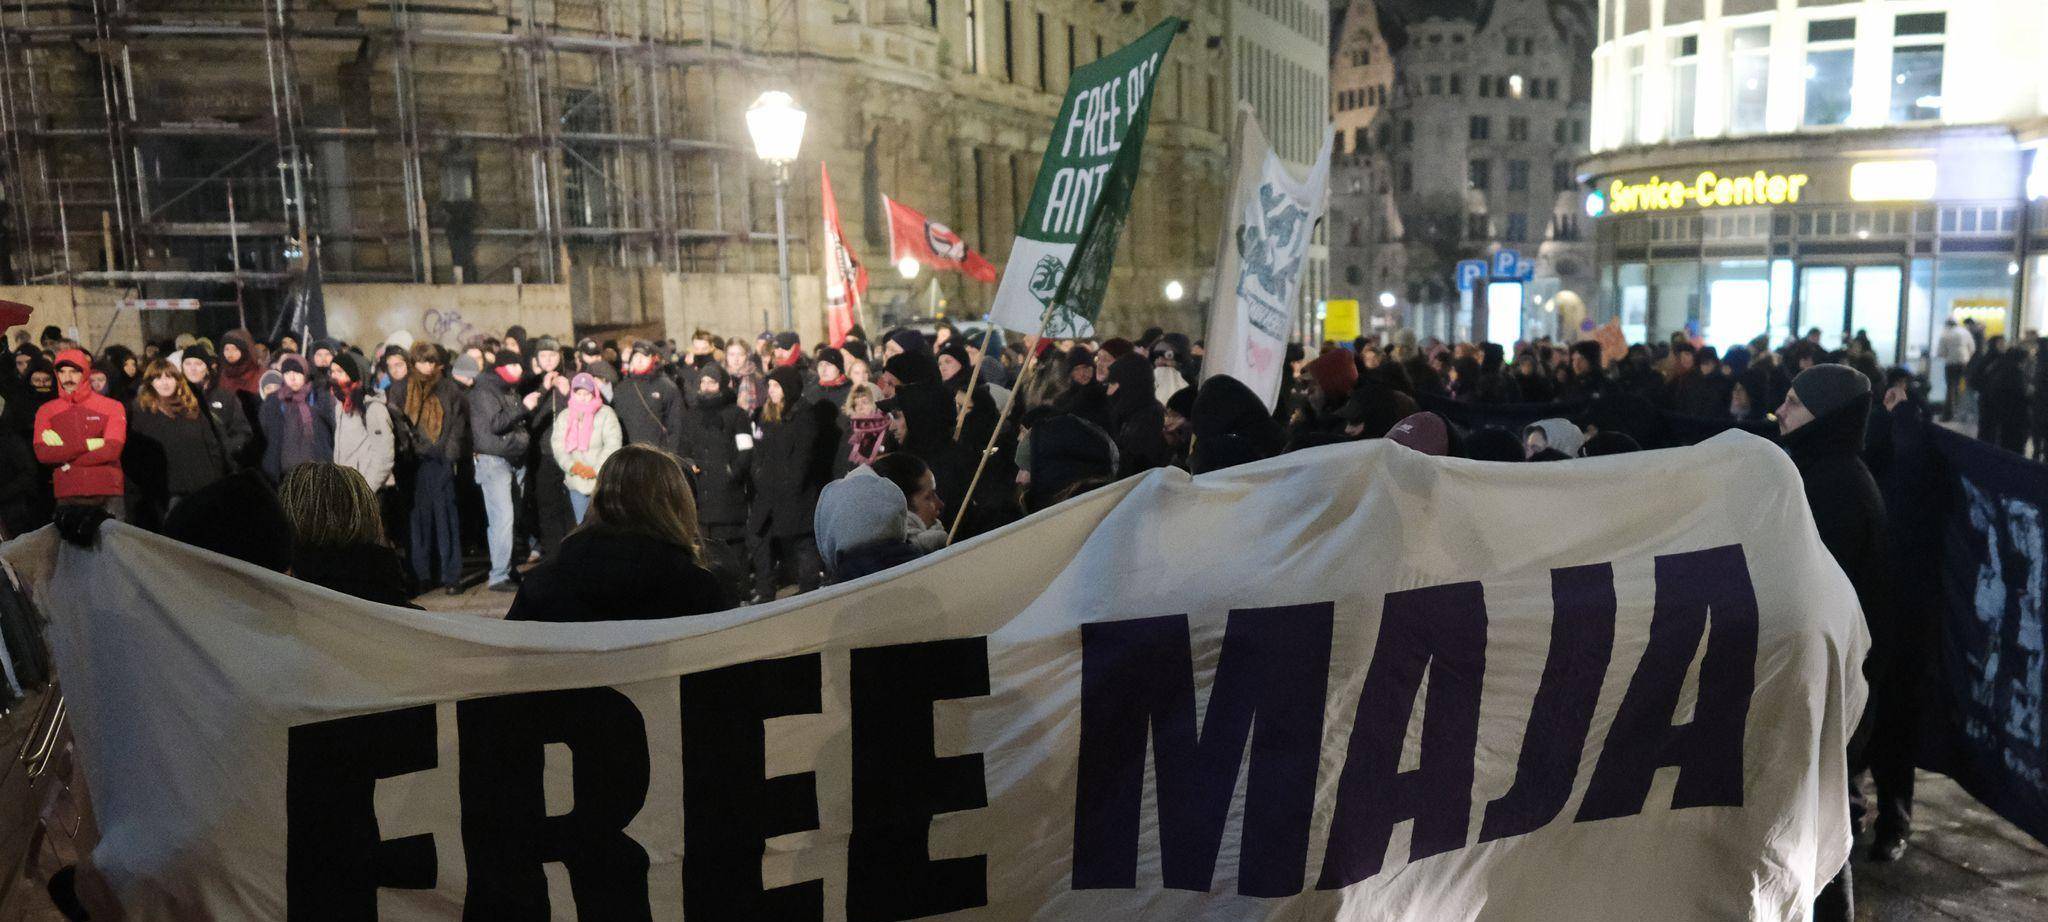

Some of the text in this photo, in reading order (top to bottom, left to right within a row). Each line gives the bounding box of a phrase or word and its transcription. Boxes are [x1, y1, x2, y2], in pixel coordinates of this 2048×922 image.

[1061, 76, 1122, 158] FREE
[1041, 163, 1112, 235] ANT
[1609, 169, 1808, 214] Service-Center
[1464, 264, 1481, 288] P
[1498, 252, 1515, 275] P
[286, 635, 991, 922] FREE
[1071, 543, 1760, 898] MAJA
